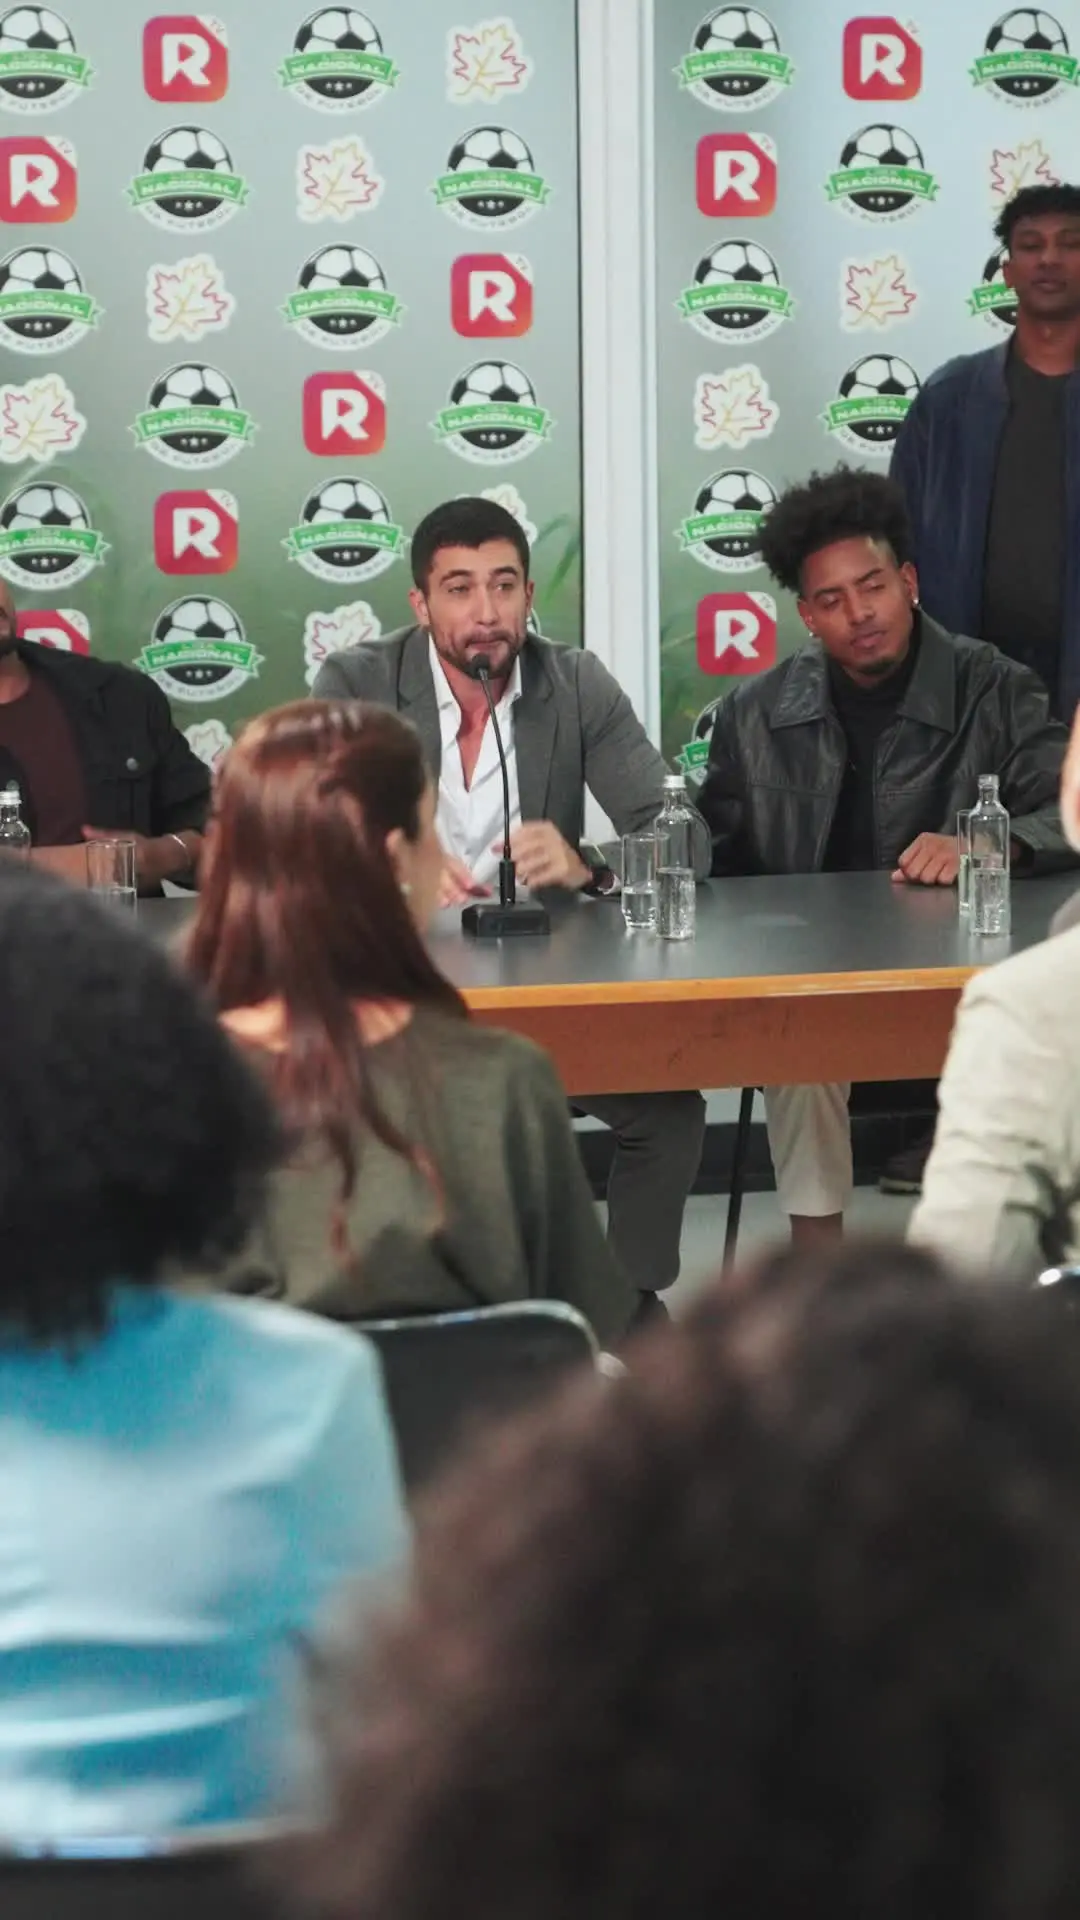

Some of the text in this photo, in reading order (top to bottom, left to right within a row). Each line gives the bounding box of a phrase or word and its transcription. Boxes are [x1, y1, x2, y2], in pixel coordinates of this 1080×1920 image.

[161, 33, 211, 87] R
[860, 33, 906, 85] R
[0, 60, 78, 75] ACIONAL
[291, 61, 385, 76] NACIONAL
[691, 60, 781, 74] NACIONAL
[982, 61, 1070, 76] NACIONAL
[9, 154, 60, 207] R
[714, 150, 760, 201] R
[837, 175, 925, 190] NACIONAL
[141, 181, 234, 195] NACIONAL
[444, 180, 535, 194] NACIONAL
[469, 270, 517, 323] R
[692, 292, 781, 306] NACIONAL
[0, 301, 84, 315] ACIONAL
[296, 299, 388, 313] NACIONAL
[322, 389, 370, 440] R
[447, 412, 537, 427] NACIONAL
[836, 406, 909, 420] NACION
[146, 417, 239, 431] NACIONAL
[173, 508, 222, 559] R
[691, 522, 766, 536] NACION
[0, 537, 91, 551] NACIONAL
[301, 531, 391, 545] NACIONAL
[714, 609, 760, 658] R
[152, 650, 244, 665] NACIONAL
